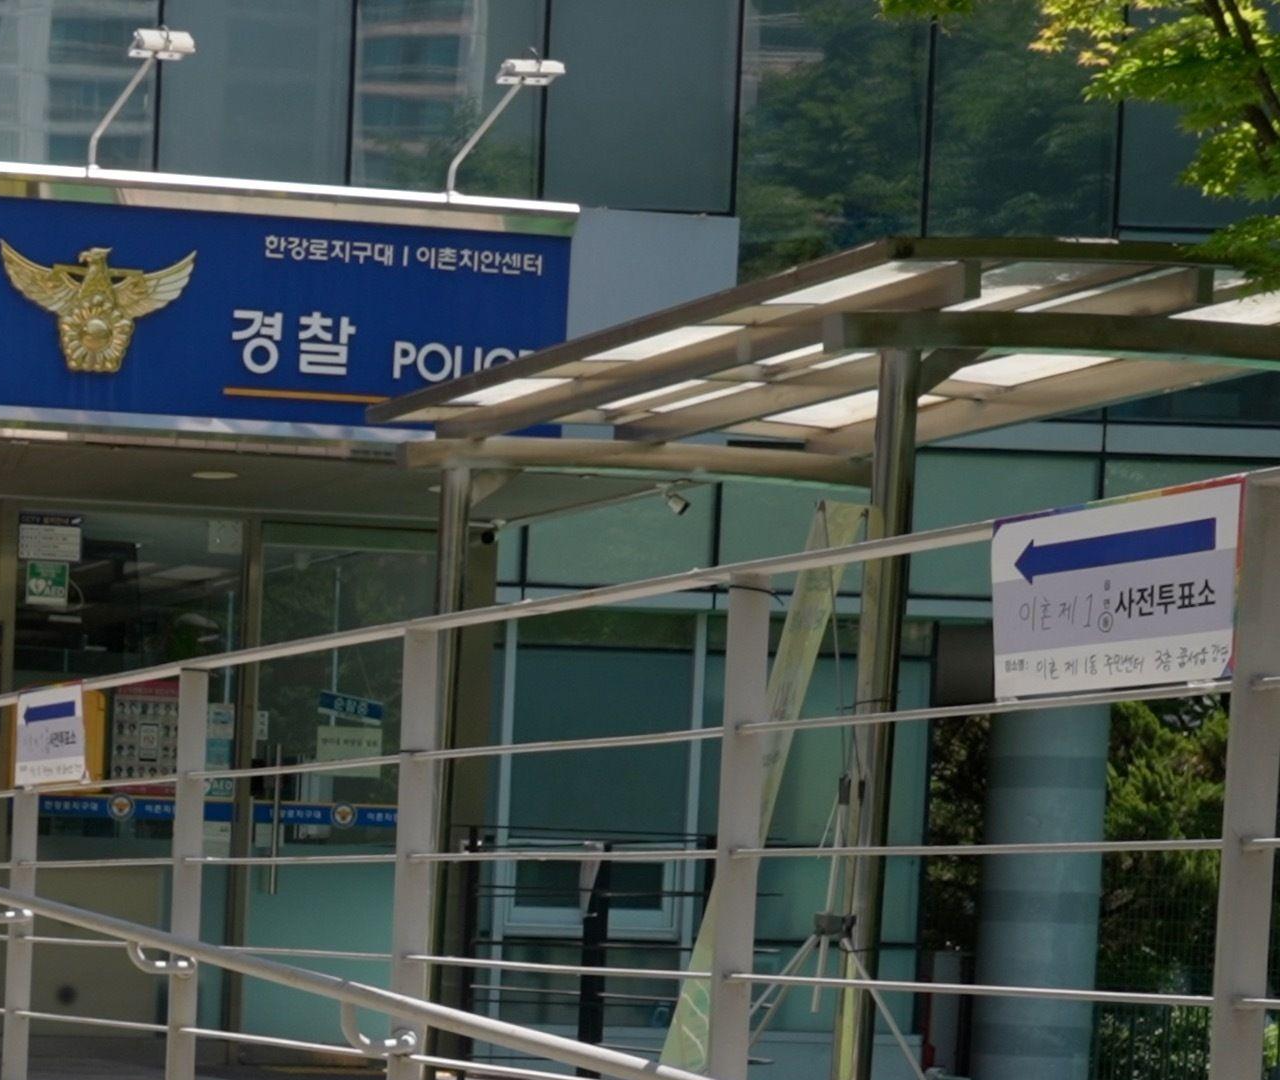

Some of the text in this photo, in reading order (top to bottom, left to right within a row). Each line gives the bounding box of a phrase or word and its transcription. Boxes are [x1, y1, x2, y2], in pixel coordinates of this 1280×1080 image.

[264, 235, 543, 276] 한강로지구대 이촌치안센터
[232, 309, 357, 375] 경찰
[1114, 577, 1217, 620] 사전투표소
